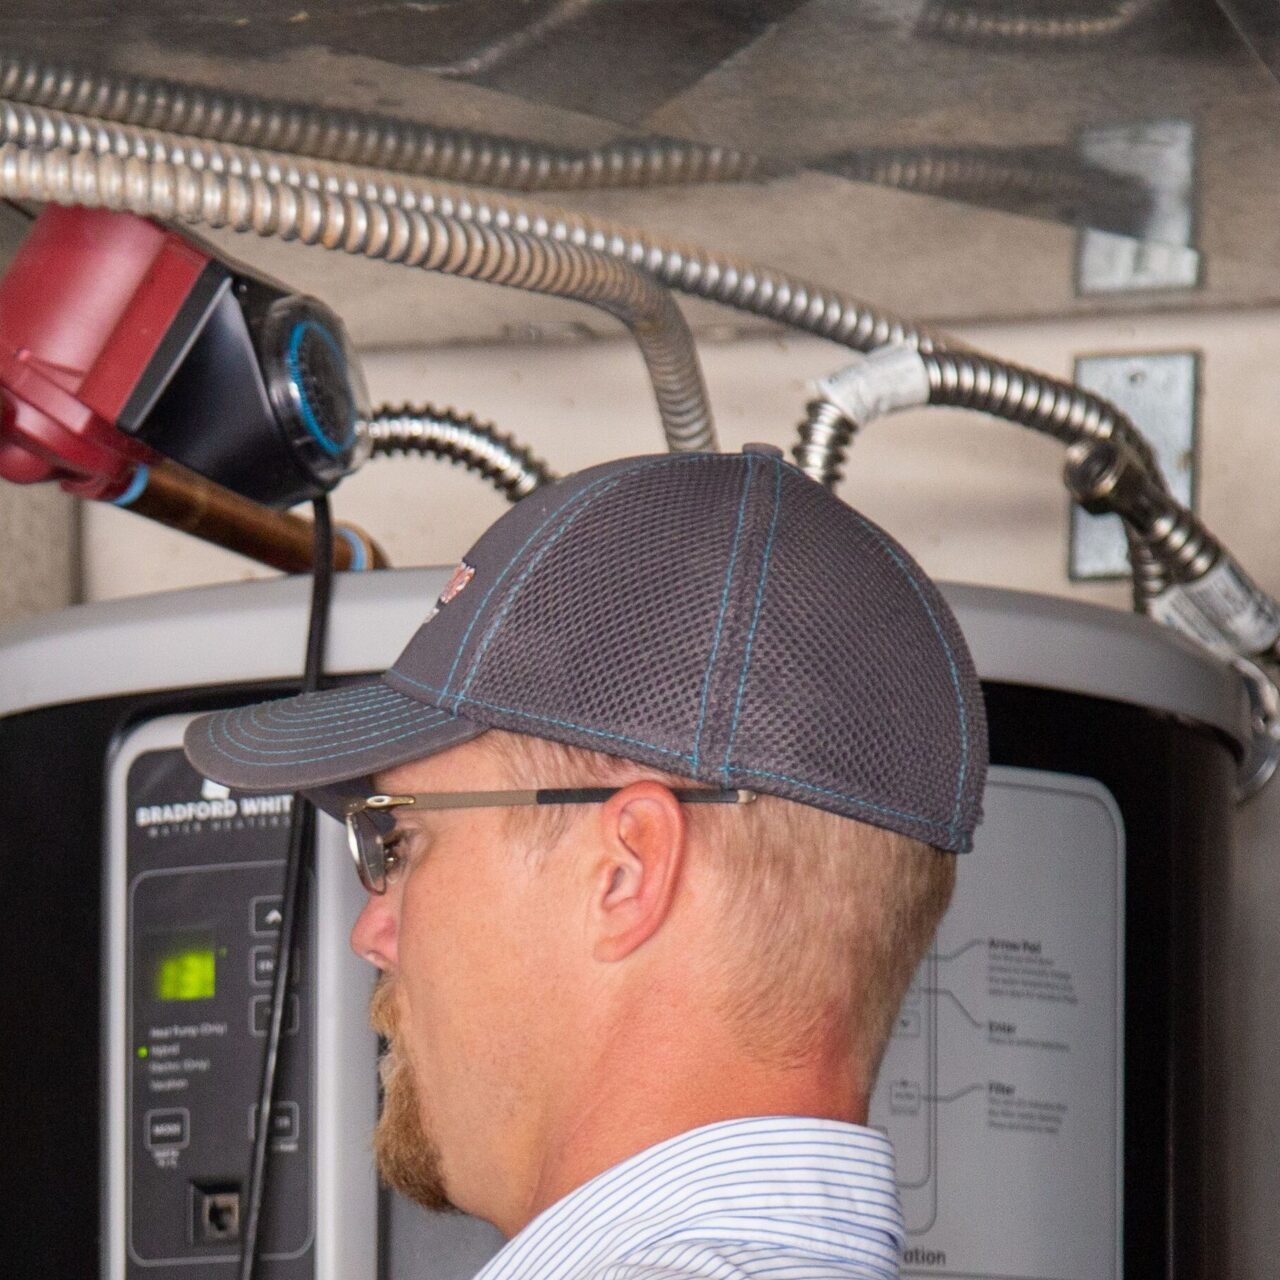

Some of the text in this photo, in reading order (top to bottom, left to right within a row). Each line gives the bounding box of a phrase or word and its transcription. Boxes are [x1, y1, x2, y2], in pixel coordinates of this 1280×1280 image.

[136, 794, 294, 827] BRADFORD WHIT
[903, 1247, 946, 1265] ation
